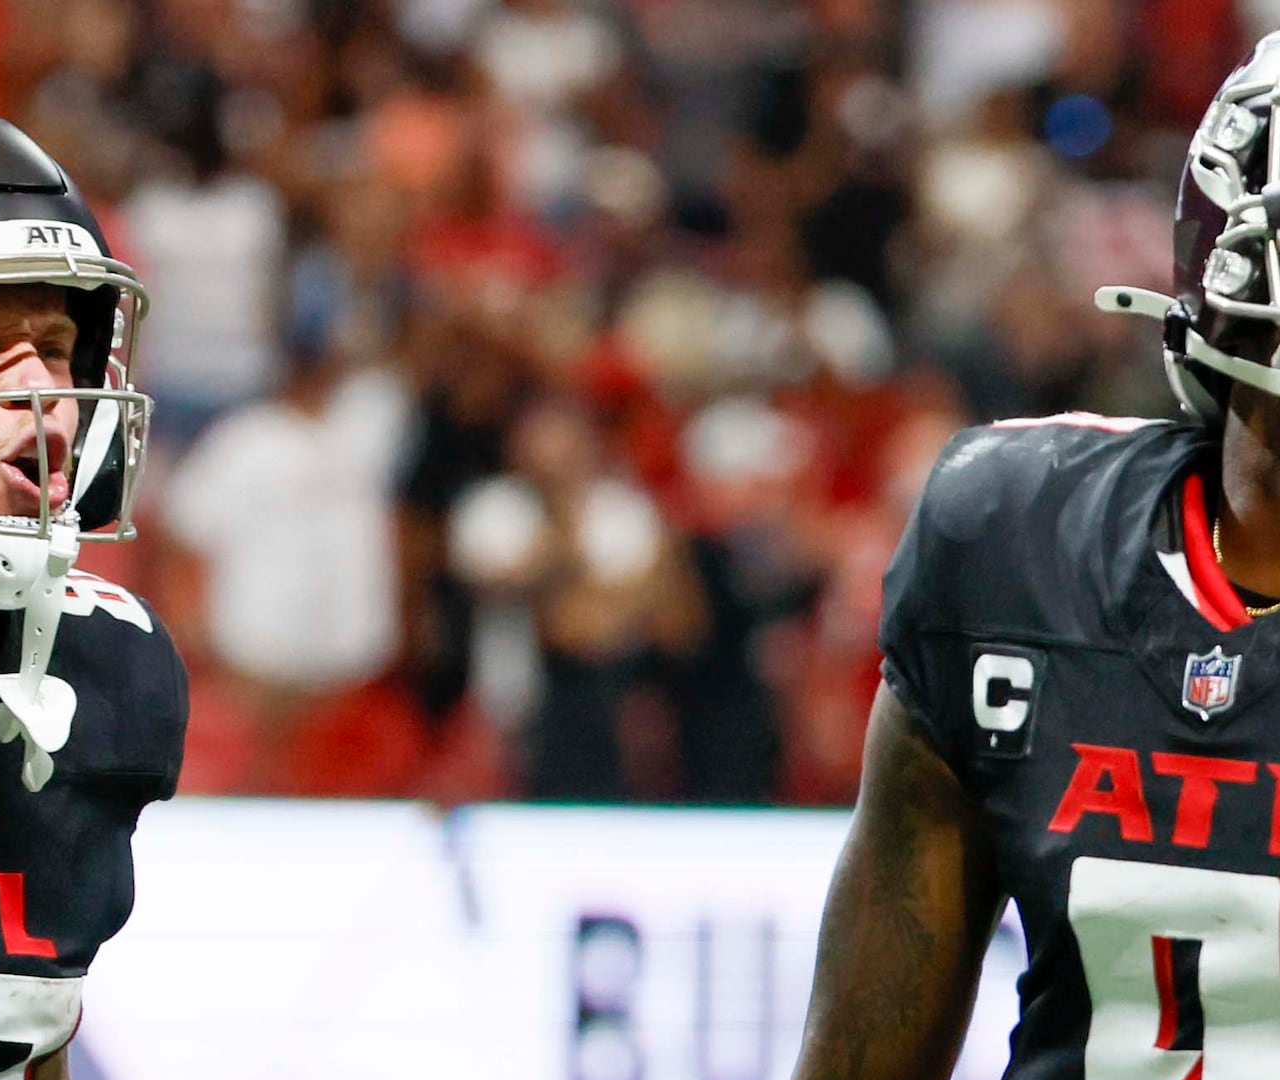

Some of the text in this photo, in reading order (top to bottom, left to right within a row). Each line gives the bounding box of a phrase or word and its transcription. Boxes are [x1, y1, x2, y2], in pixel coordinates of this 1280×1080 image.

[24, 226, 82, 248] ATL
[972, 653, 1035, 732] C
[1189, 676, 1228, 706] NFL
